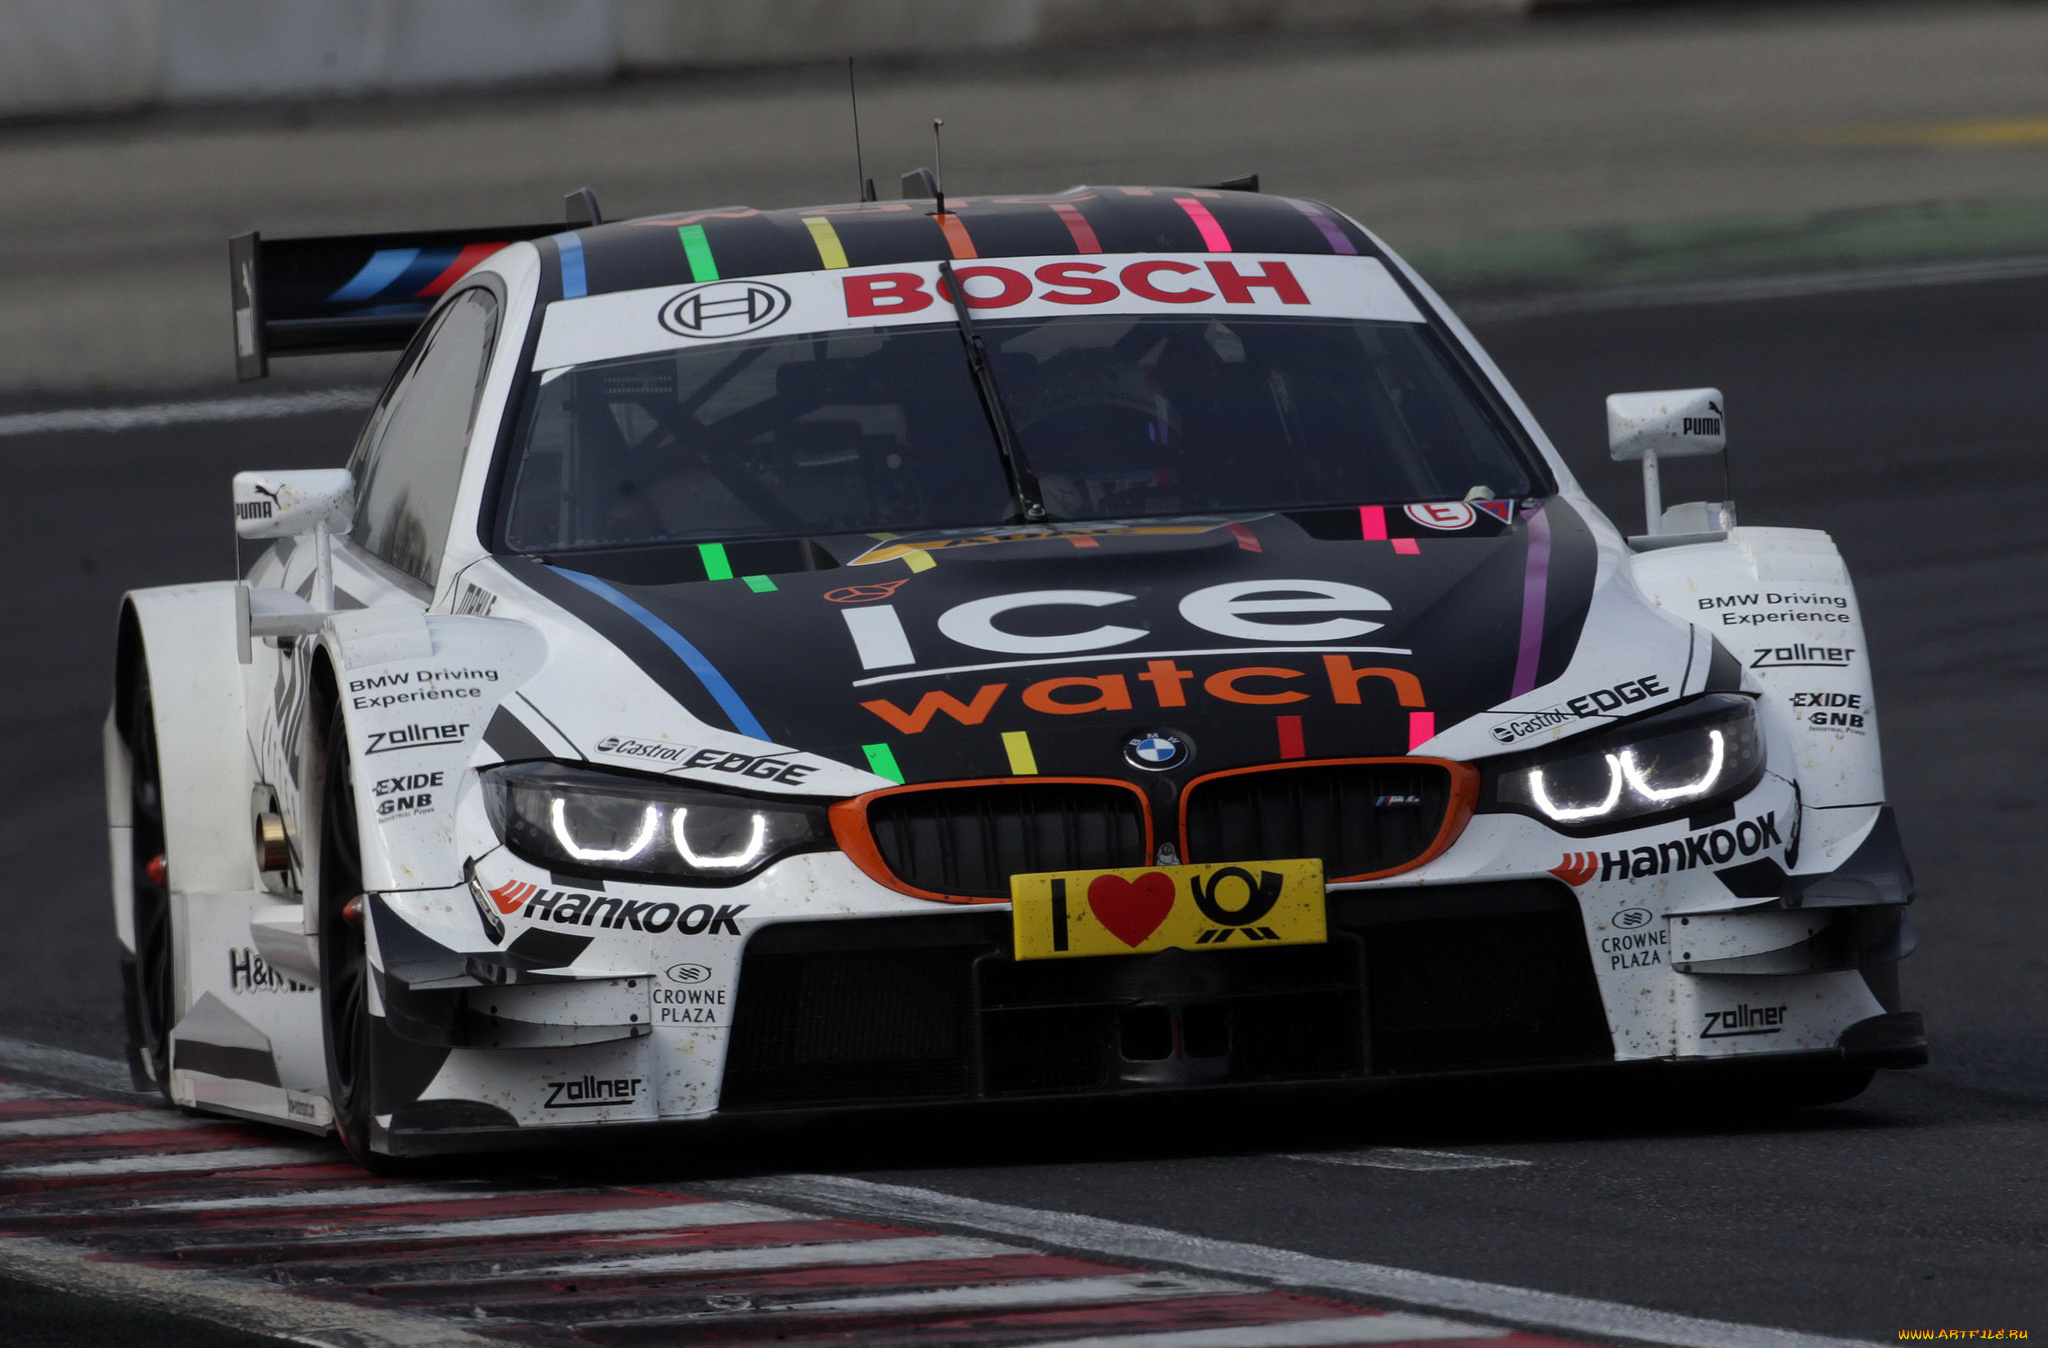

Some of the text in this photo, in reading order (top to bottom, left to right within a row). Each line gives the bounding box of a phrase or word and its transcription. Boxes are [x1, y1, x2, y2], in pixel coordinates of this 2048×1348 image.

[842, 260, 1312, 318] BOSCH
[1683, 417, 1720, 436] PUMA
[1698, 592, 1848, 611] BMW Driving
[824, 578, 1393, 671] ice
[1722, 610, 1851, 627] Experience
[349, 668, 499, 693] BMW Driving
[352, 686, 482, 710] Experience
[859, 654, 1426, 735] watch
[1510, 674, 1670, 737] Castrol EDGE
[1789, 692, 1862, 710] EXIDE
[1808, 711, 1865, 729] GNB
[1129, 732, 1181, 747] BMW
[615, 740, 822, 787] Castrol EDGE
[372, 771, 445, 798] EXIDE
[377, 793, 433, 817] GNB
[1050, 878, 1069, 953] I
[1601, 929, 1668, 954] CROWNE
[1611, 949, 1662, 971] PLAZA
[652, 989, 726, 1006] CROWNE
[661, 1007, 717, 1024] PLAZA
